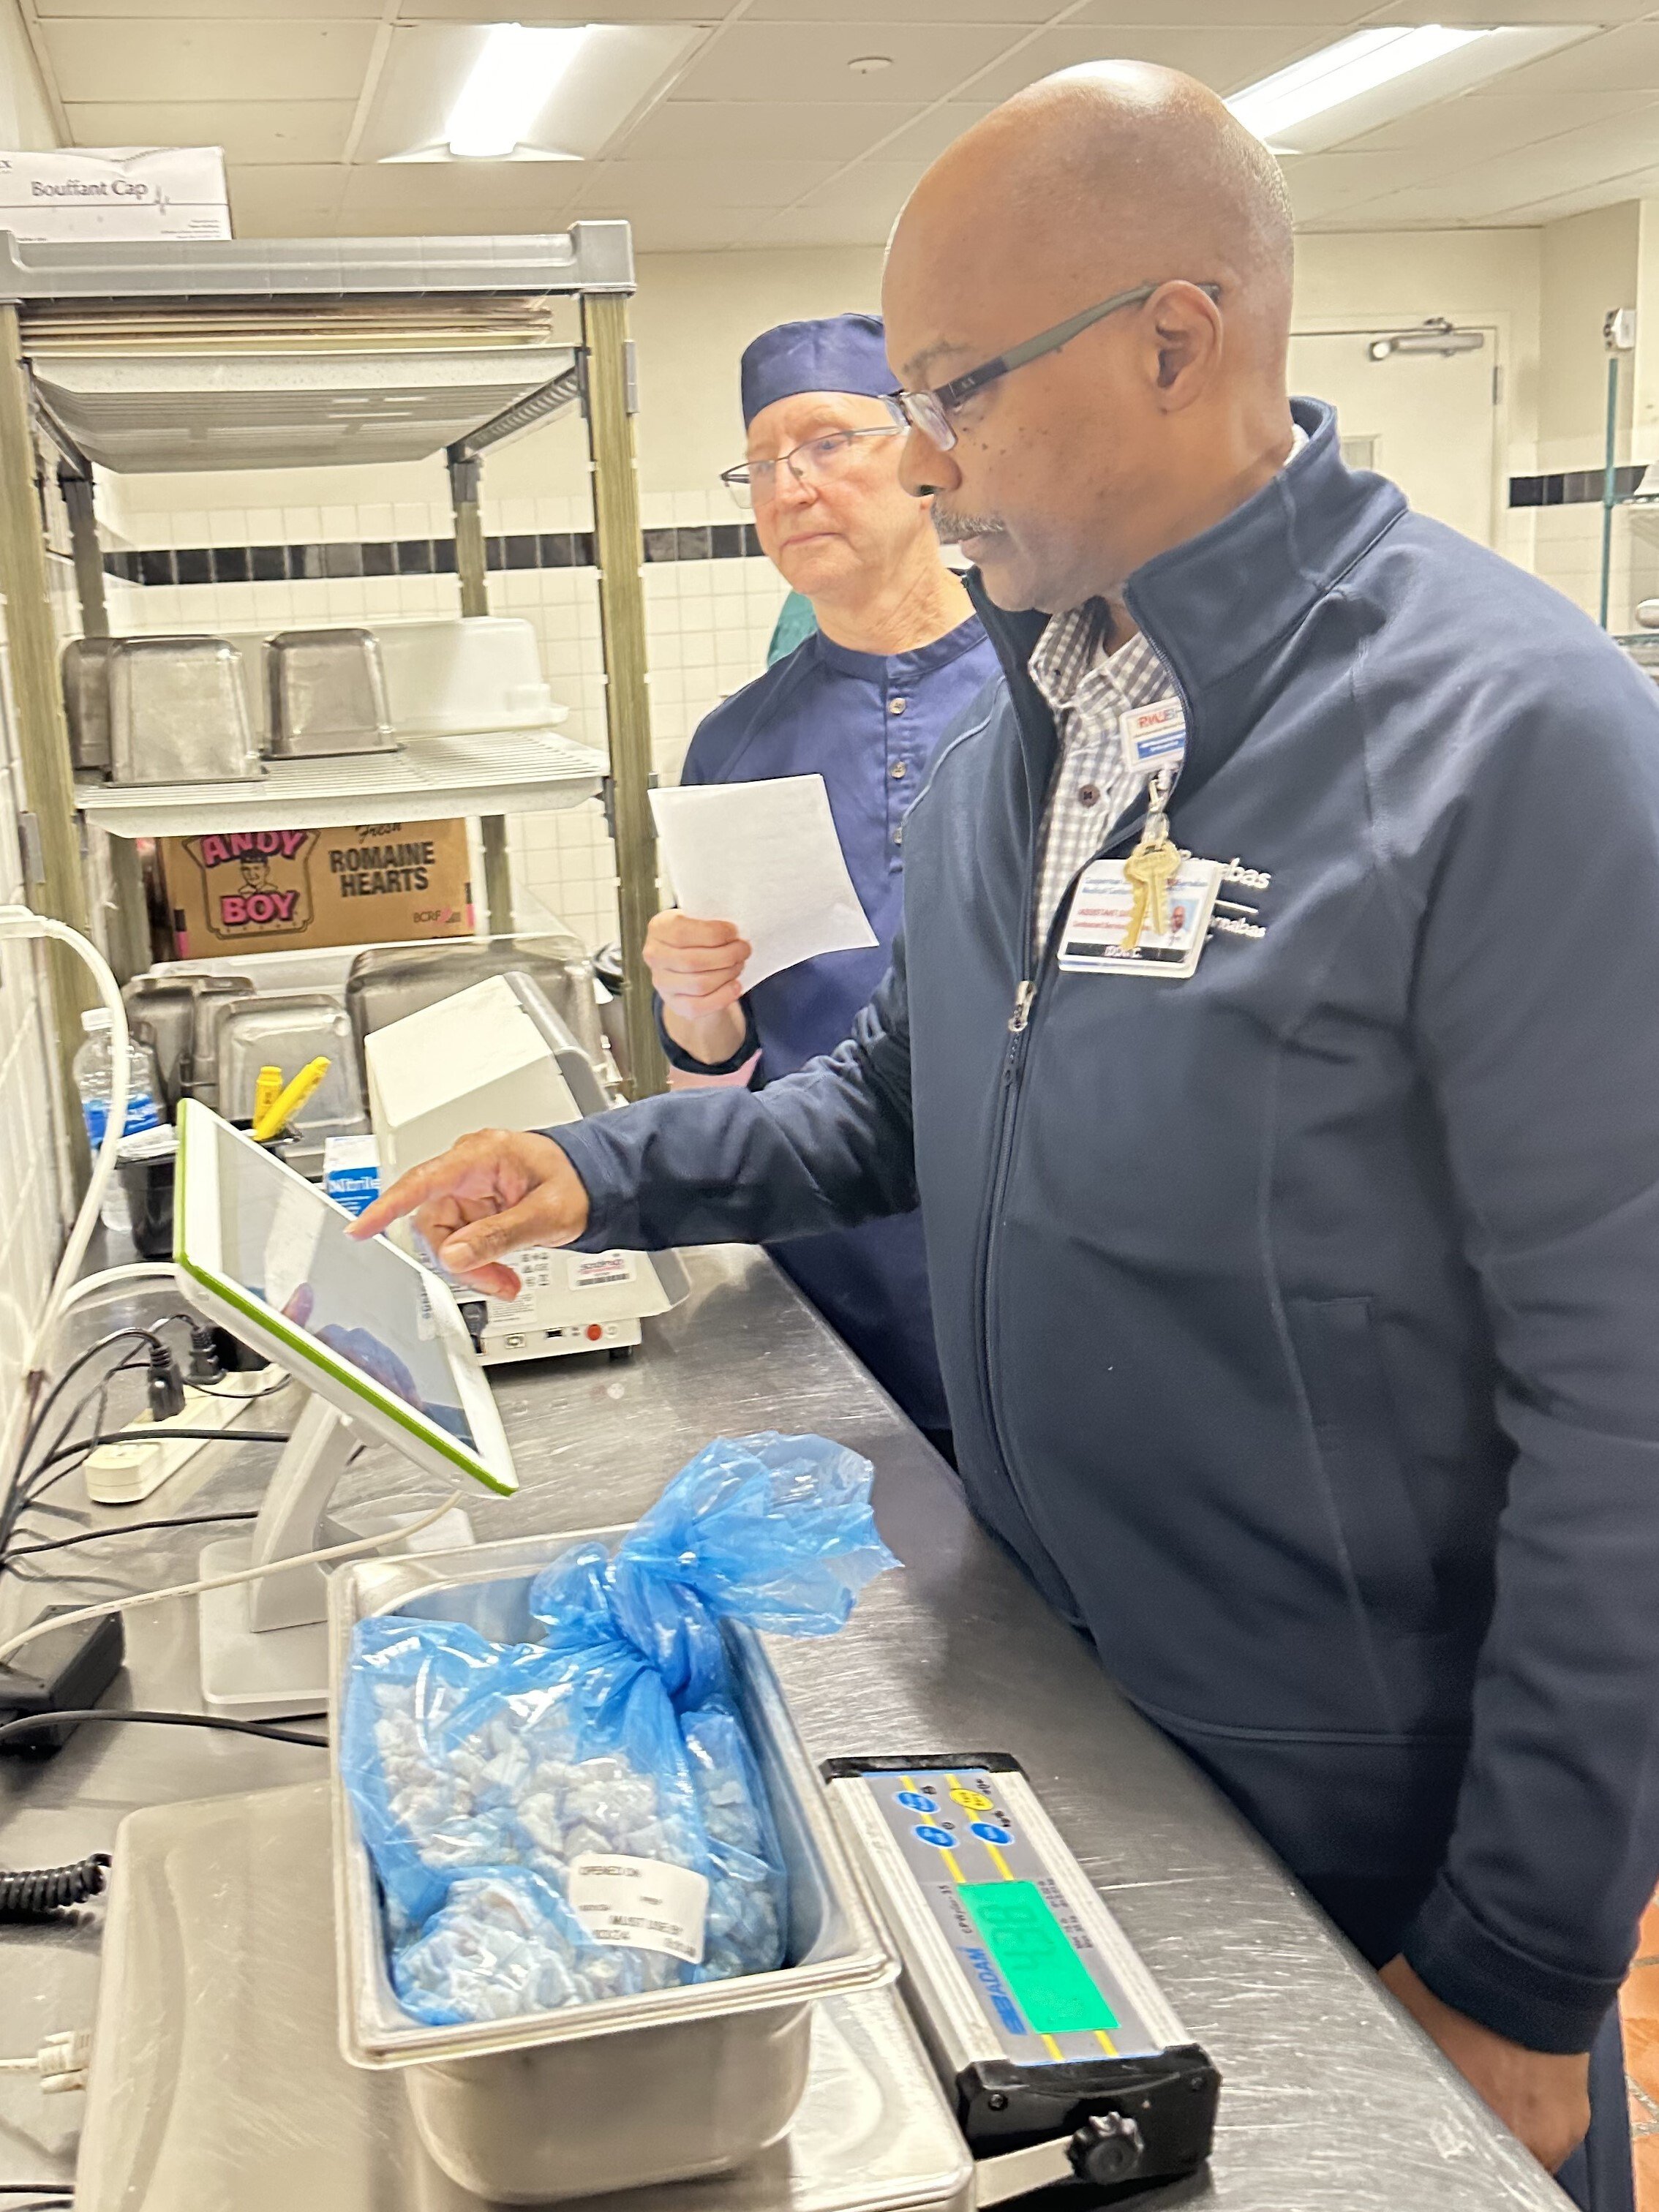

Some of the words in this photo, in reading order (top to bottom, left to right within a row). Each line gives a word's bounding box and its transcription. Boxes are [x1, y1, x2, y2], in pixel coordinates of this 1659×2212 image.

[31, 179, 108, 196] Bouffant
[111, 179, 148, 200] Cap
[328, 840, 436, 873] ROMAINE
[339, 865, 429, 898] HEARTS
[220, 889, 301, 926] BOY
[326, 1175, 383, 1194] Nitrile
[963, 1946, 1007, 1995] ADAM
